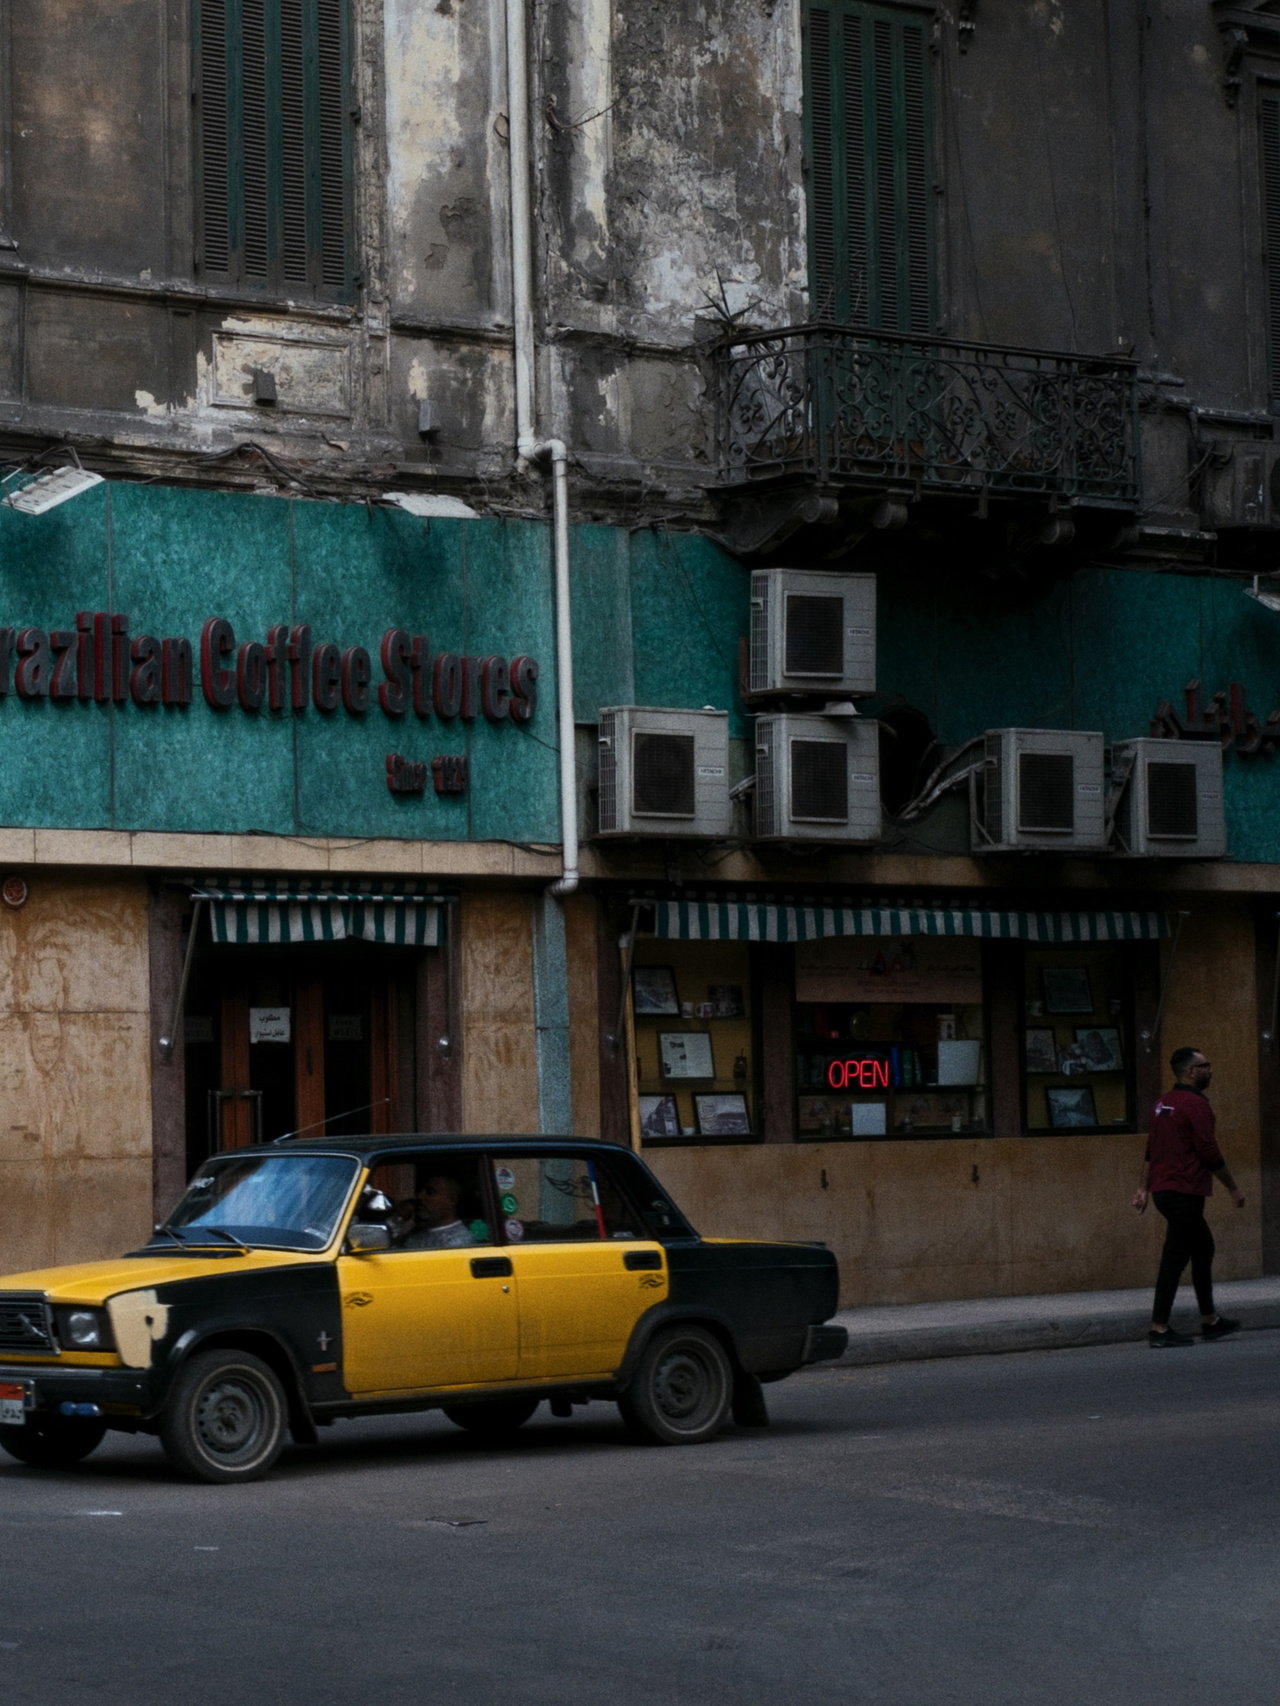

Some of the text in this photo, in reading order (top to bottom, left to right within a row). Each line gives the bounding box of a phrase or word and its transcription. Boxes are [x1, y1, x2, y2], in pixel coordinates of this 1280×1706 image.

[201, 617, 372, 712] Coffee
[379, 627, 540, 723] Stores
[828, 1059, 890, 1089] OPEN
